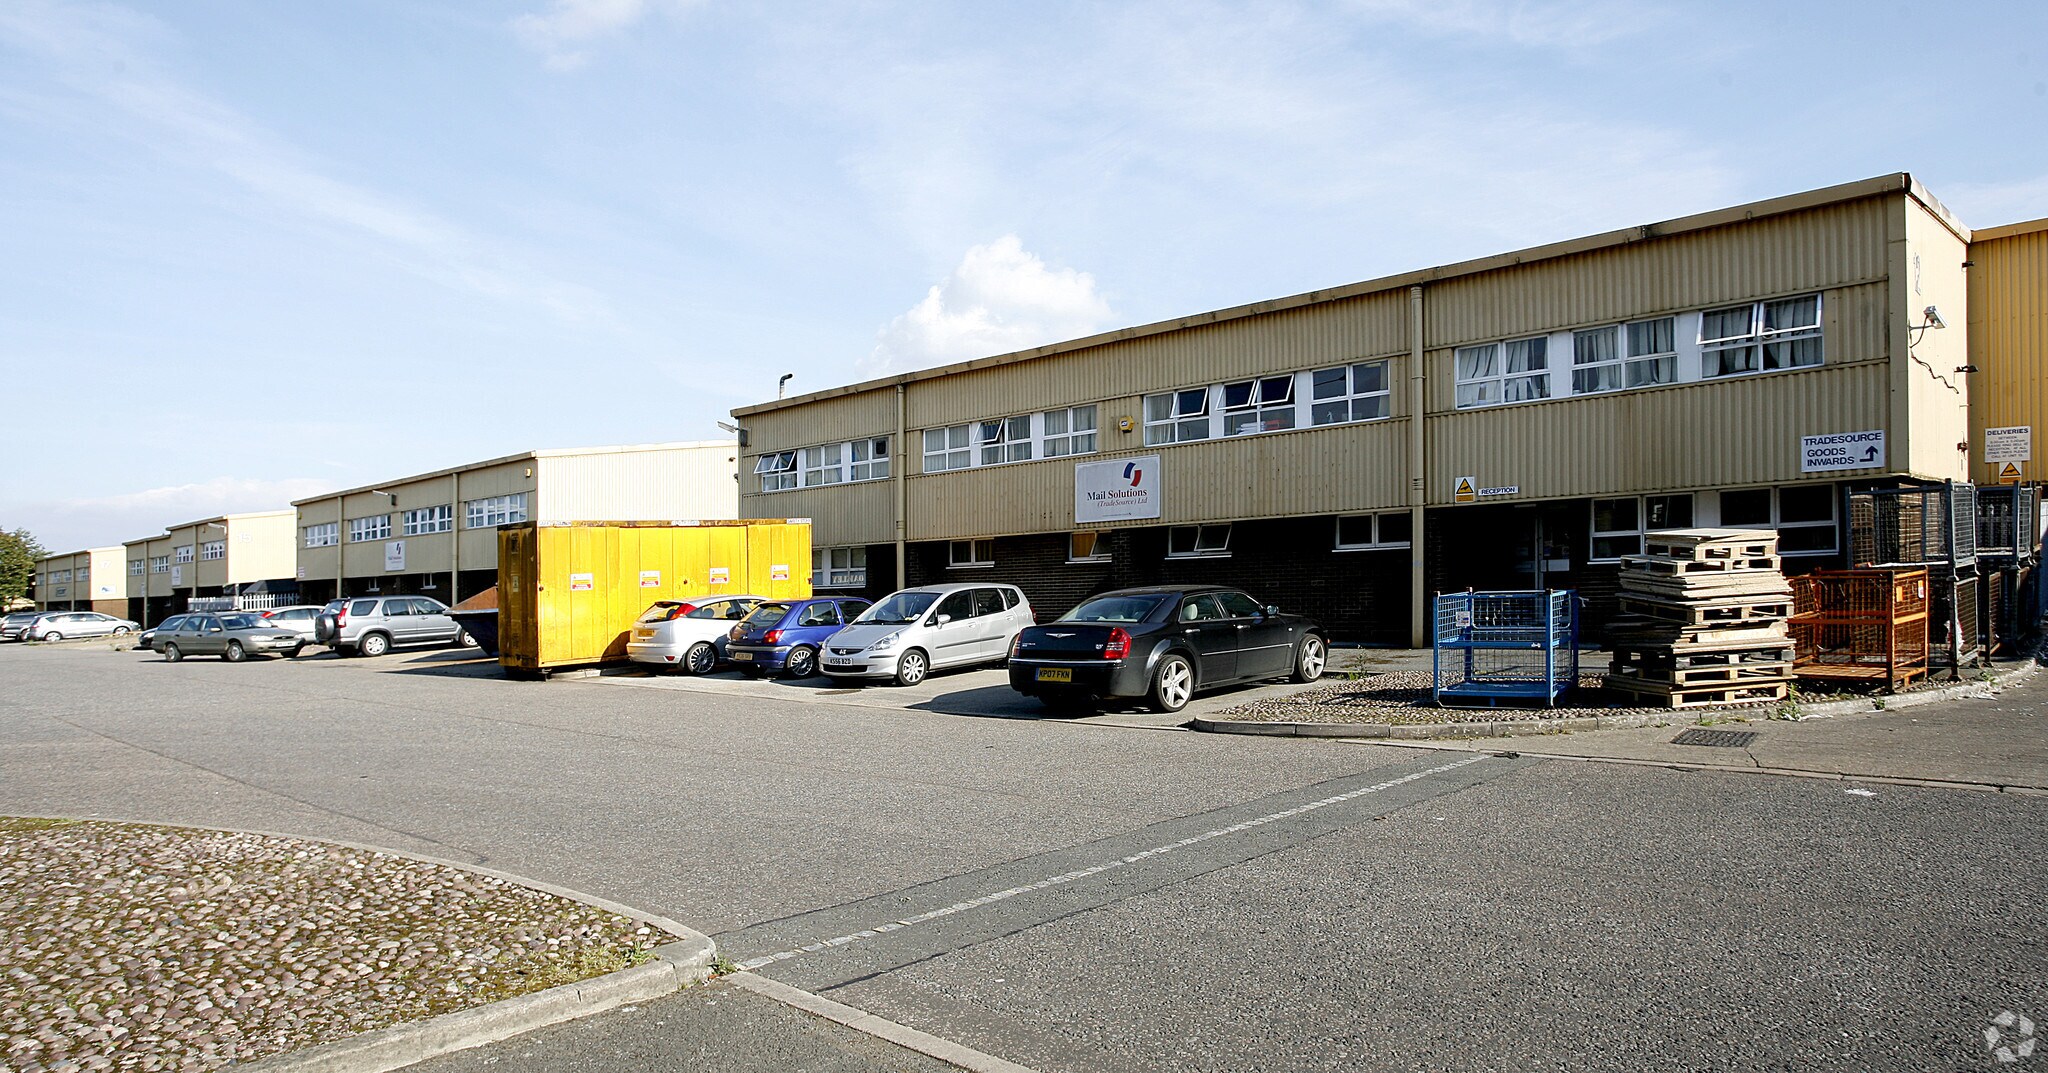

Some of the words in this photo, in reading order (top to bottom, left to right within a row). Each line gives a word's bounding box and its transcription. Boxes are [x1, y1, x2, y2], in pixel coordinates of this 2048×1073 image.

[1804, 432, 1882, 446] TRADESOURCE
[1807, 447, 1846, 457] GOODS
[1808, 456, 1855, 466] INWARDS
[1087, 490, 1106, 501] Mail
[1107, 488, 1147, 499] Solutions
[1097, 499, 1137, 507] (TradeSource)
[1039, 670, 1055, 678] KP07
